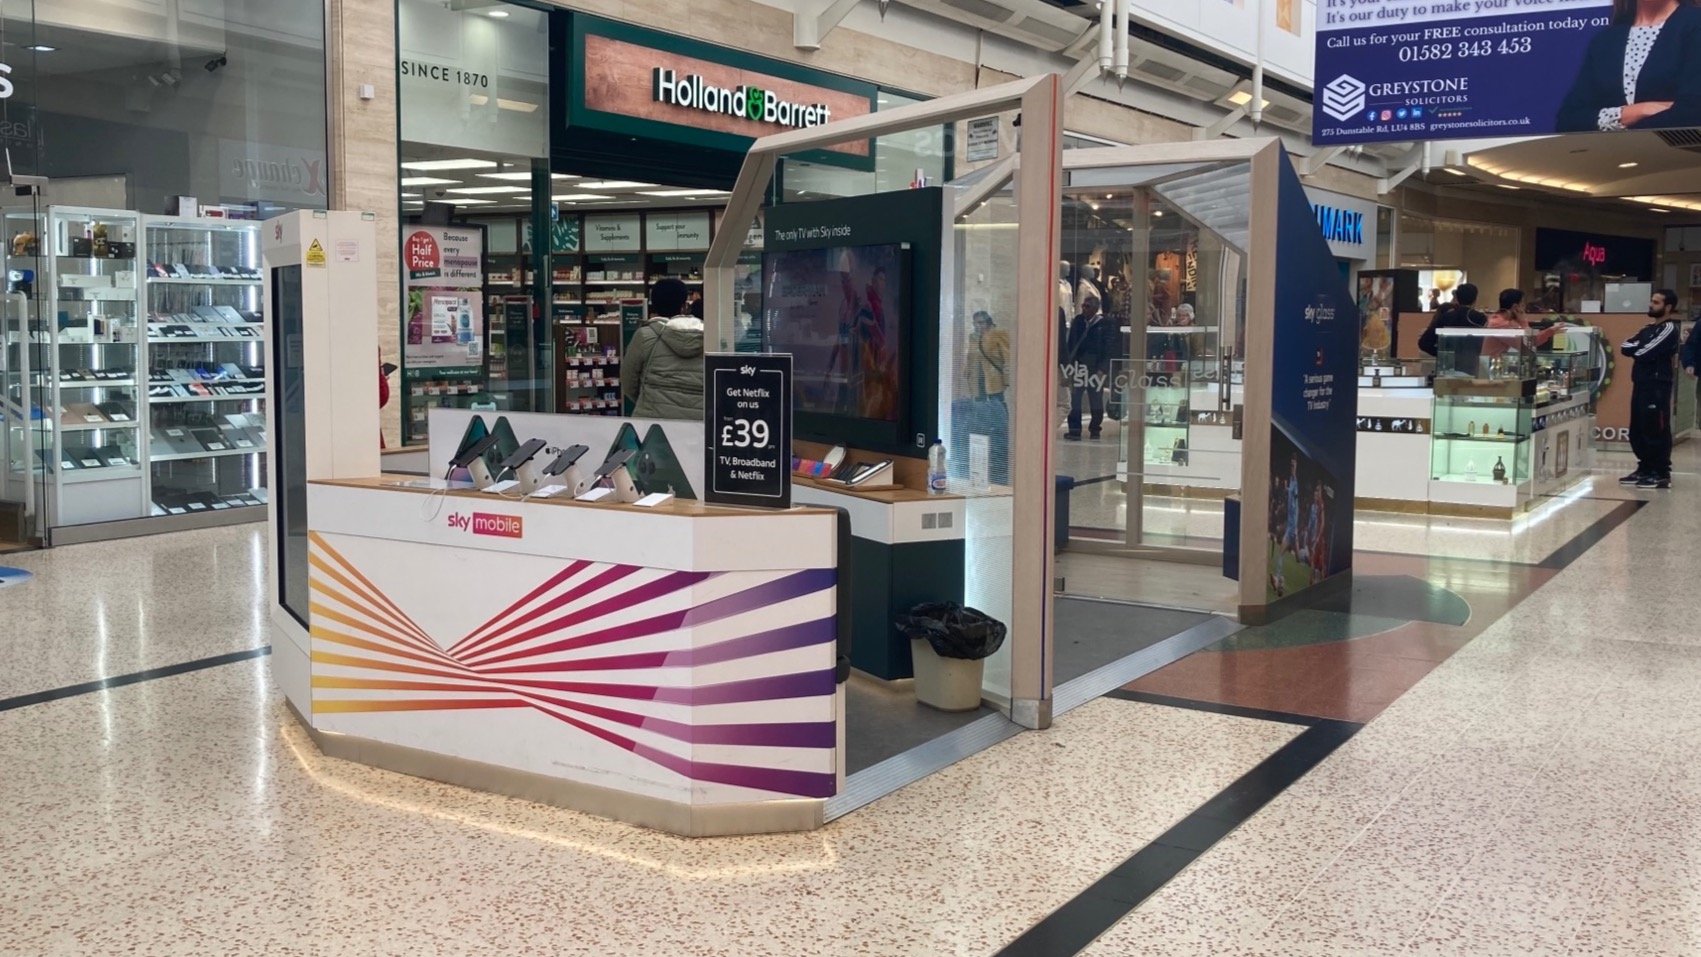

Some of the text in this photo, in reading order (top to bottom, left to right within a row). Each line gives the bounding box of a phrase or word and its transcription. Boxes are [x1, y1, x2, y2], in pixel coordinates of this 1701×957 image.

[1327, 12, 1346, 24] It's
[1349, 11, 1374, 21] our
[1376, 7, 1408, 20] duty
[1413, 5, 1427, 15] to
[1431, 0, 1471, 14] make
[1474, 0, 1508, 13] your
[1327, 16, 1609, 48] Call us for your FREE consultation today on
[1399, 37, 1532, 62] 01582 343 453
[401, 61, 488, 88] SINCE 1870
[1369, 77, 1468, 96] GREYSTONE
[654, 67, 746, 118] Holland
[764, 90, 831, 128] Barrett
[1405, 95, 1468, 106] SOLICITORS
[1336, 126, 1374, 136] Dunstable
[1391, 124, 1408, 132] LU4
[1430, 117, 1531, 132] greystonesolicitors.co.uk
[443, 232, 468, 242] Because
[775, 230, 785, 240] The
[786, 230, 798, 242] only
[798, 228, 807, 239] TV
[807, 228, 820, 239] with
[820, 226, 831, 239] Sky
[832, 225, 851, 237] inside
[412, 244, 432, 255] Half
[1583, 242, 1605, 266] Aqua
[412, 256, 434, 267] Price
[450, 269, 477, 278] different
[740, 365, 756, 377] sky
[1073, 369, 1107, 392] sky
[1114, 369, 1182, 395] glass
[727, 388, 770, 398] Get Netflix
[737, 401, 759, 409] on us
[721, 419, 769, 448] £39
[720, 456, 776, 468] TV, Broadband
[730, 470, 765, 480] & Netflix
[448, 512, 520, 533] sky mobile
